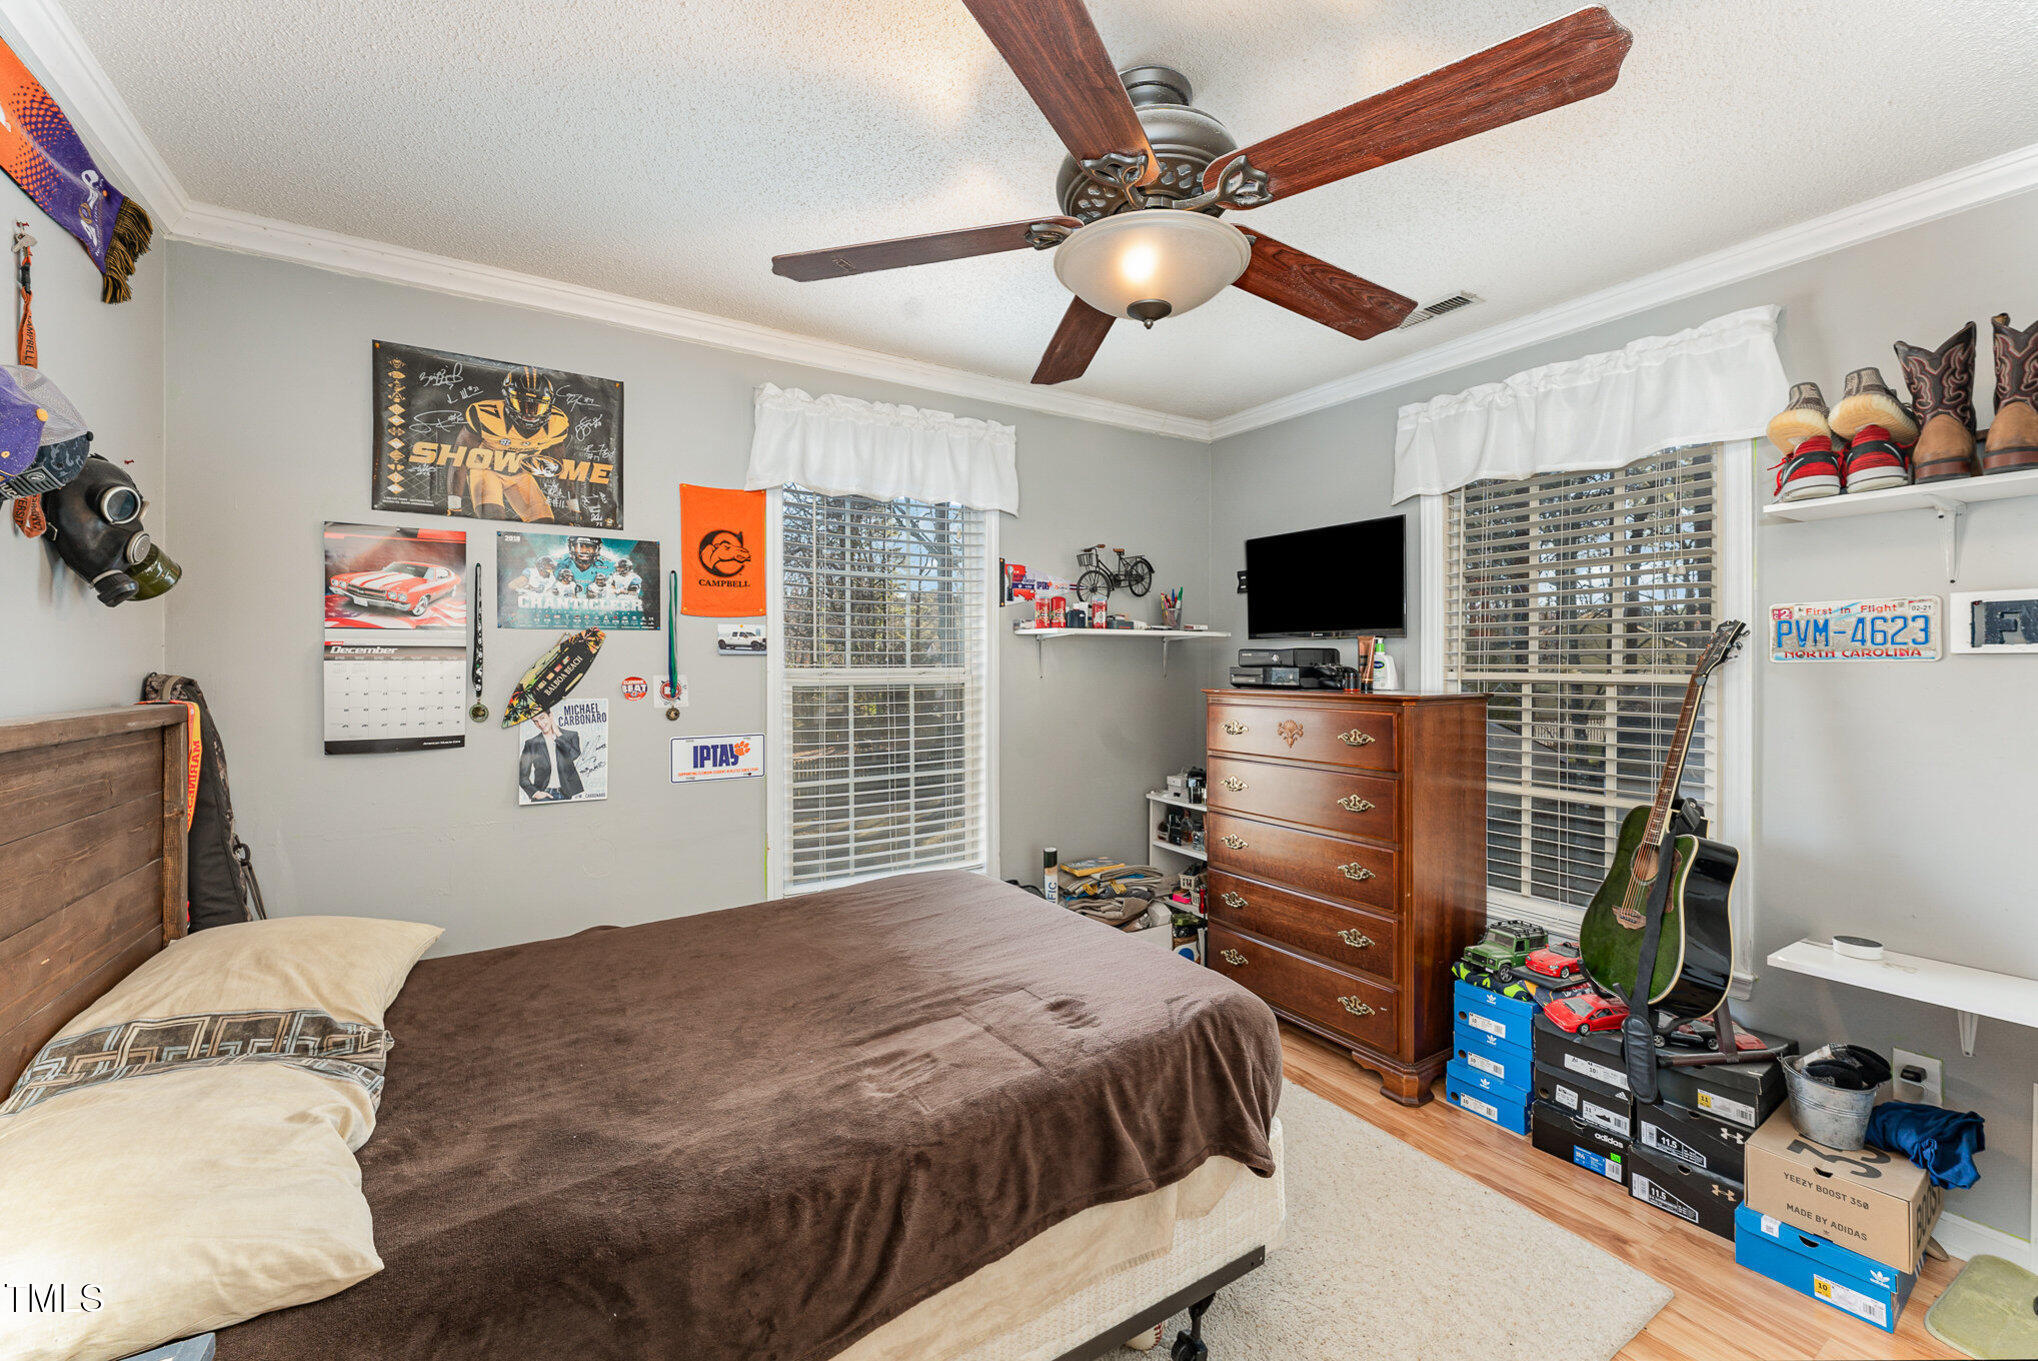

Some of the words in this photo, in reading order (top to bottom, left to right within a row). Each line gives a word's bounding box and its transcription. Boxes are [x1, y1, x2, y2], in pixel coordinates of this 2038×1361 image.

[408, 441, 527, 473] SHOW
[561, 458, 614, 485] ME
[698, 578, 750, 588] CAMPBELL
[1806, 607, 1832, 615] First
[1860, 604, 1896, 614] Flight
[1776, 615, 1930, 648] PVM-4623
[330, 646, 398, 655] December
[1784, 649, 1835, 659] NORTH
[1841, 647, 1922, 657] CAROLINA
[543, 671, 567, 697] BALBOA
[565, 655, 583, 675] BEACH
[563, 703, 600, 715] MICHAEL
[558, 712, 607, 727] CARBONARO
[1594, 1133, 1624, 1149] adidas
[1661, 1136, 1678, 1149] 11.5
[1651, 1187, 1667, 1201] 11.5
[1783, 1171, 1814, 1189] YEEZY
[1816, 1184, 1847, 1202] BOOST
[1850, 1197, 1870, 1210] 350
[1786, 1202, 1813, 1220] MADE
[1815, 1214, 1829, 1225] BY
[1830, 1221, 1868, 1241] ADIDAS
[1818, 1282, 1828, 1291] 10
